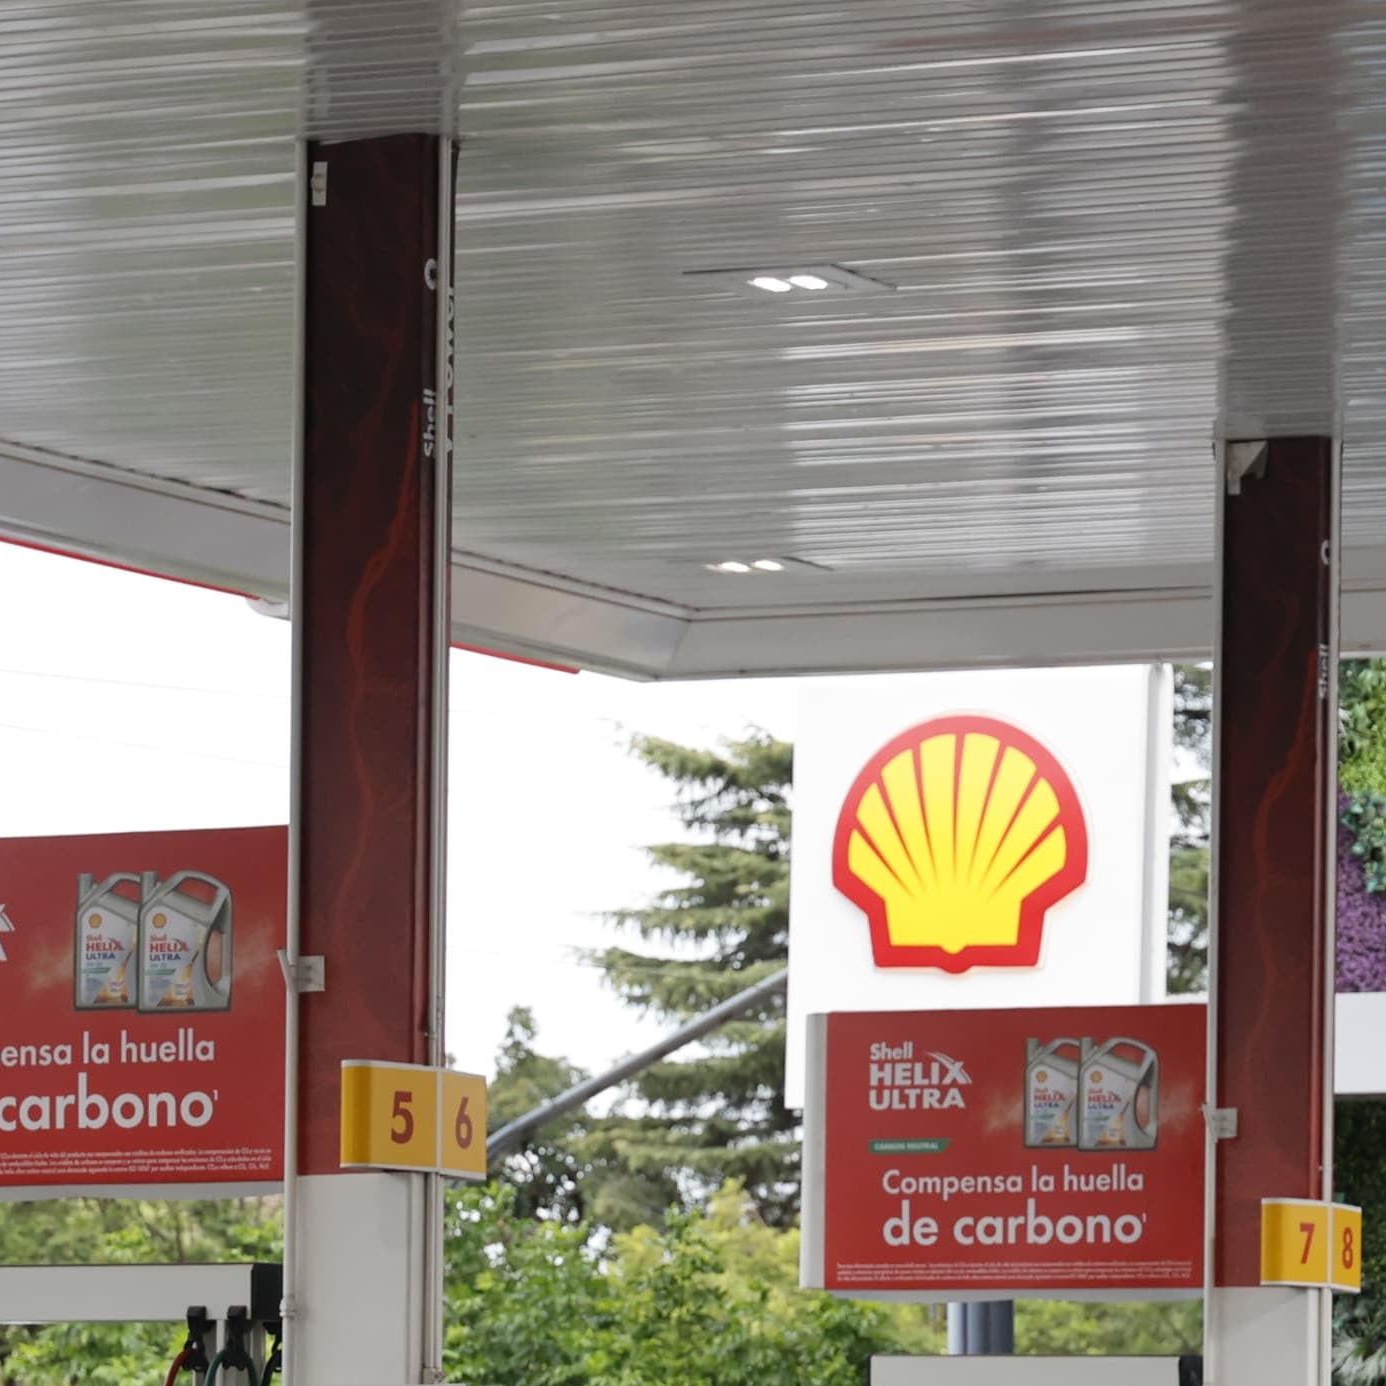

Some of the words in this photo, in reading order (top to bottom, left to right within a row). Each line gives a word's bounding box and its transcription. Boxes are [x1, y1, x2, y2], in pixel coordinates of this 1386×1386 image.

[83, 1032, 110, 1063] la
[120, 1028, 214, 1062] huella
[870, 1041, 913, 1060] Shell
[869, 1058, 971, 1086] HELIX
[391, 1091, 414, 1144] 5
[869, 1087, 966, 1110] ULTRA
[455, 1096, 473, 1149] 6
[882, 1168, 1023, 1200] Compensa
[1031, 1165, 1054, 1192] la
[1063, 1164, 1144, 1191] huella
[882, 1200, 939, 1246] de
[1300, 1222, 1315, 1264] 7
[1342, 1226, 1353, 1269] 8
